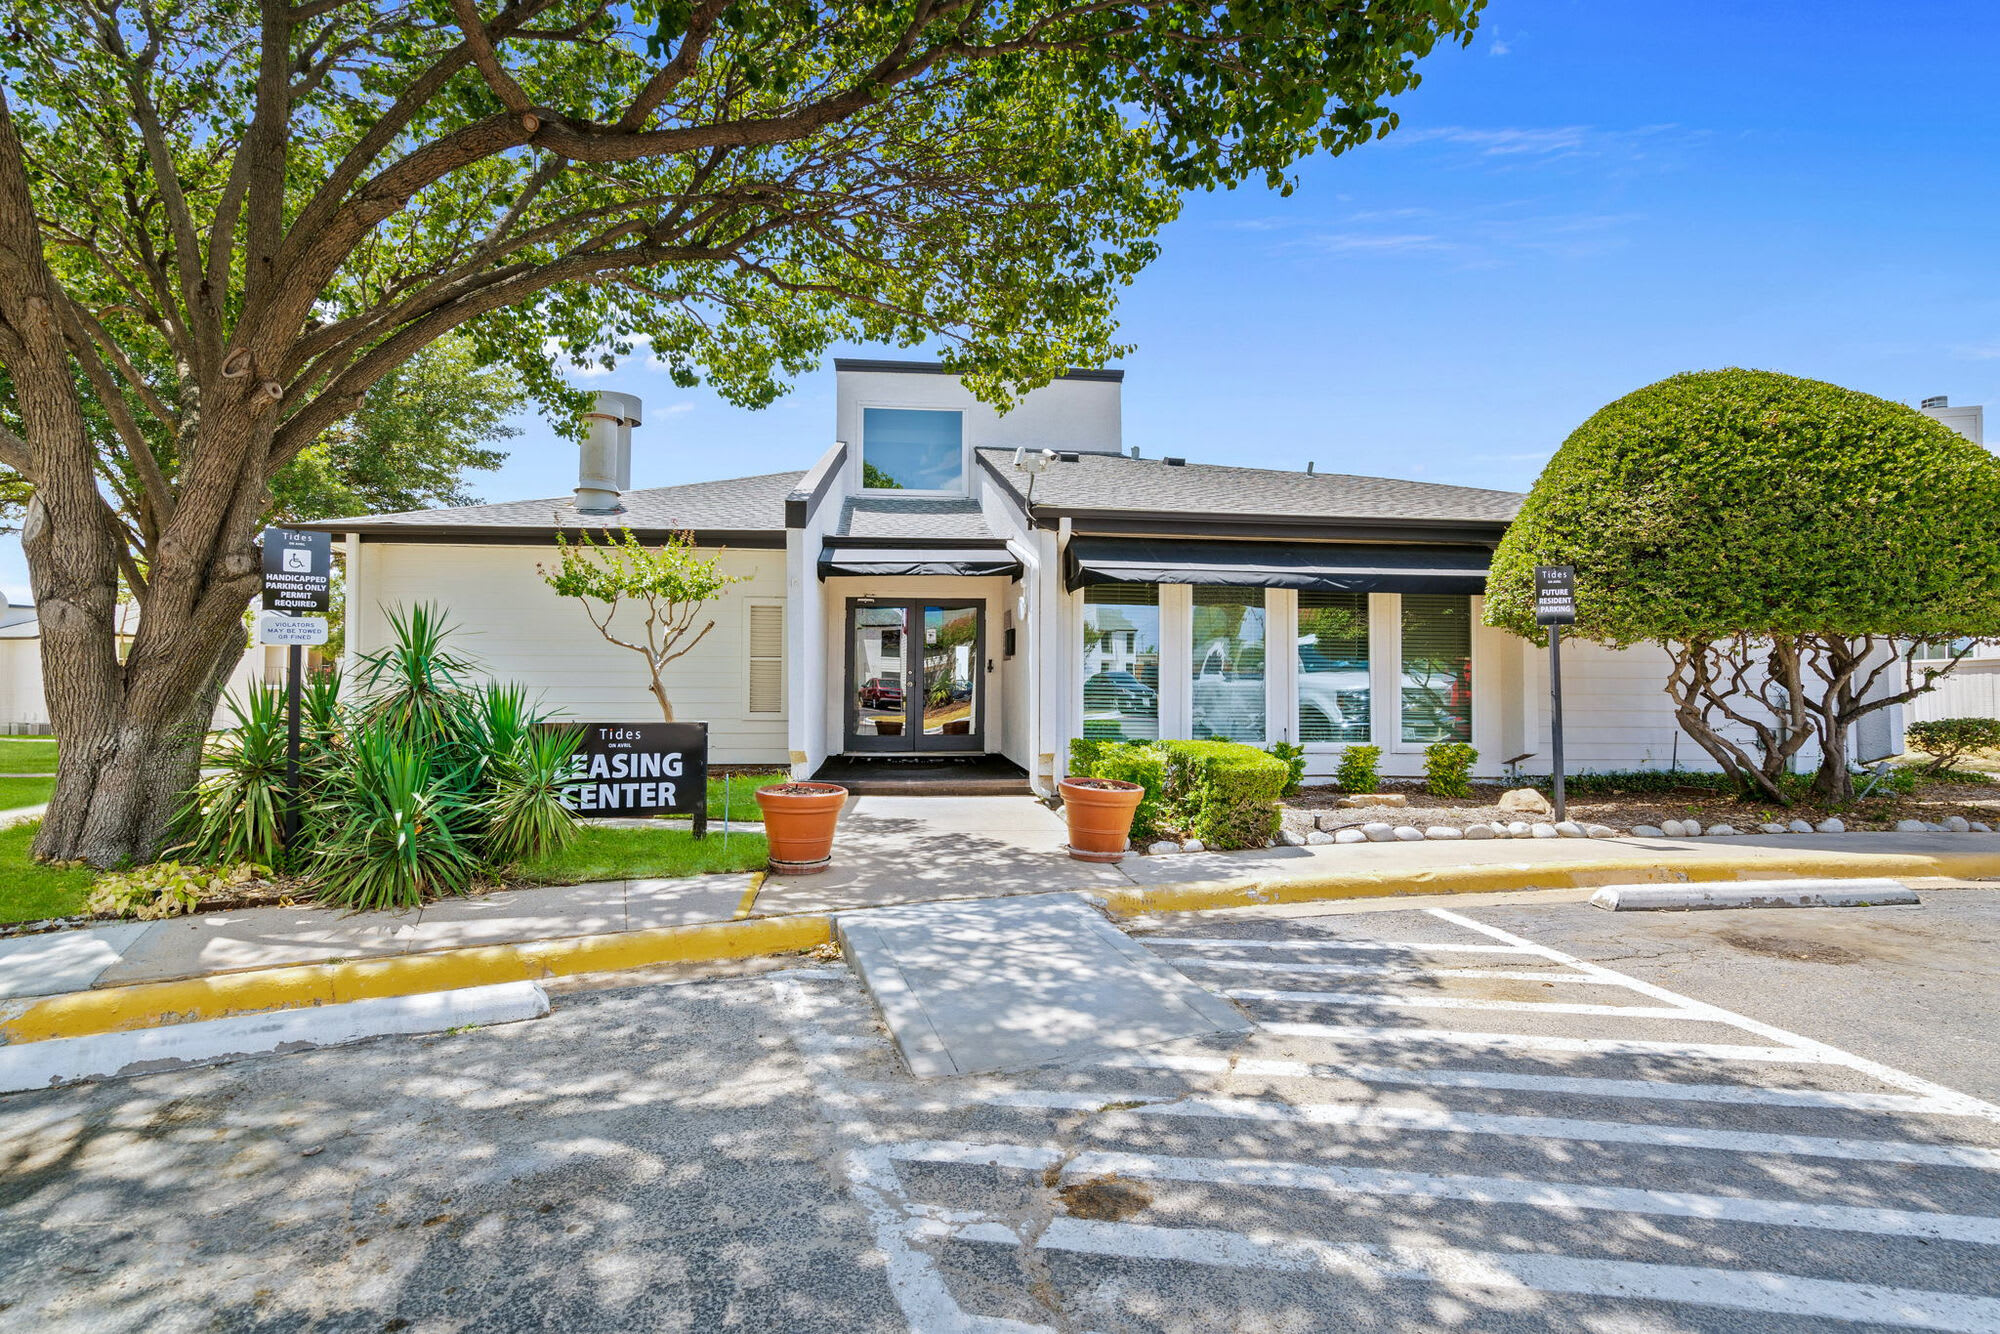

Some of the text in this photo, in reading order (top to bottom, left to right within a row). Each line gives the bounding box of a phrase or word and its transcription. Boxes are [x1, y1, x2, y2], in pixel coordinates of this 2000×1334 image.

[282, 532, 312, 542] Tides
[266, 573, 327, 583] HANDICAPPED
[1542, 570, 1567, 578] Tides
[266, 582, 303, 590] PARKING
[599, 728, 641, 740] Tides
[559, 782, 676, 810] CENTER
